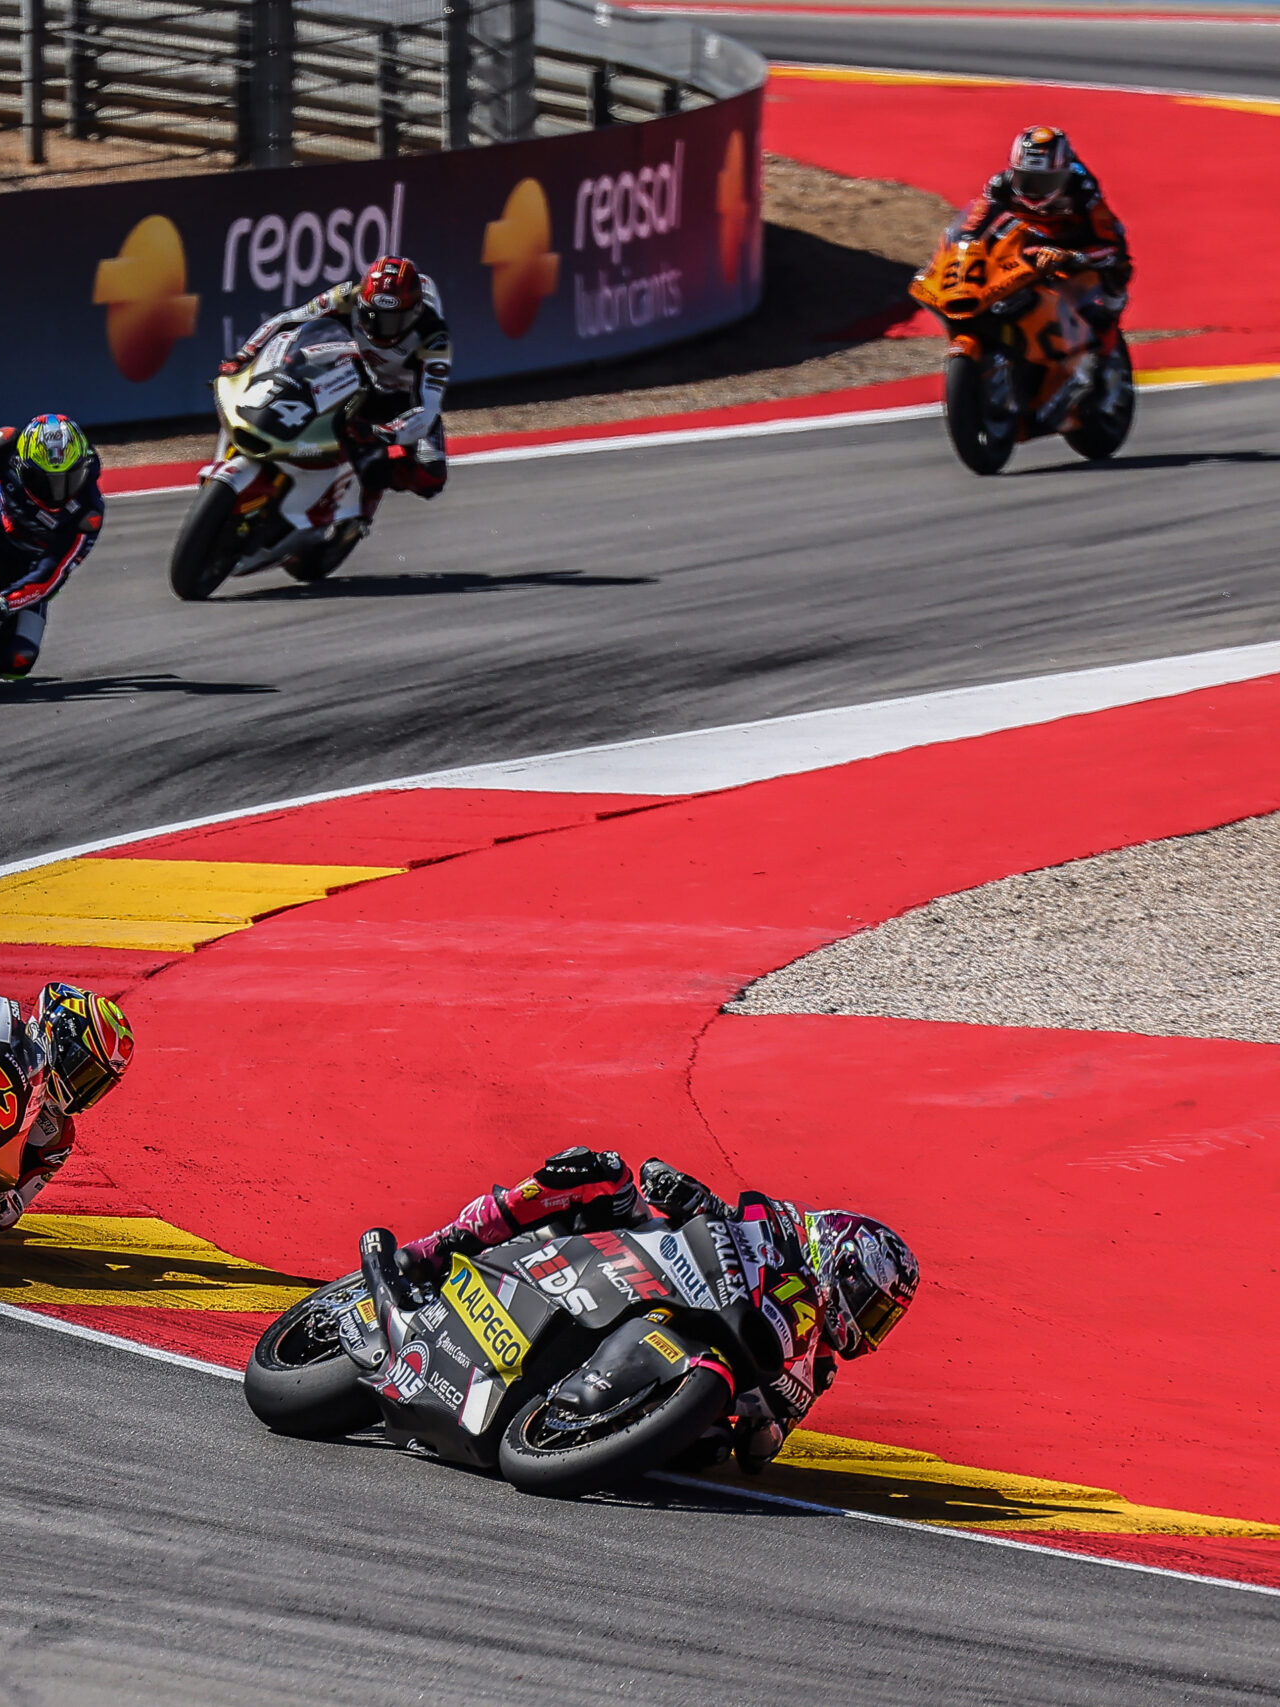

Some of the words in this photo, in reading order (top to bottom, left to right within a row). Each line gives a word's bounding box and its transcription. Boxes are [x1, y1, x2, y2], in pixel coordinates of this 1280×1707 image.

[575, 140, 684, 265] repsol
[222, 183, 406, 307] repsol
[4, 1052, 29, 1092] HONDA
[596, 1261, 641, 1304] RACIN
[673, 1253, 708, 1302] mut
[706, 1220, 748, 1305] PALLEX
[715, 1278, 730, 1308] ITALIA
[768, 1272, 819, 1341] 14
[461, 1286, 523, 1368] ALPEGO
[646, 1334, 680, 1362] PIRELLI
[388, 1357, 427, 1399] NILS
[429, 1371, 464, 1405] IVECO
[768, 1373, 812, 1414] PALLEX
